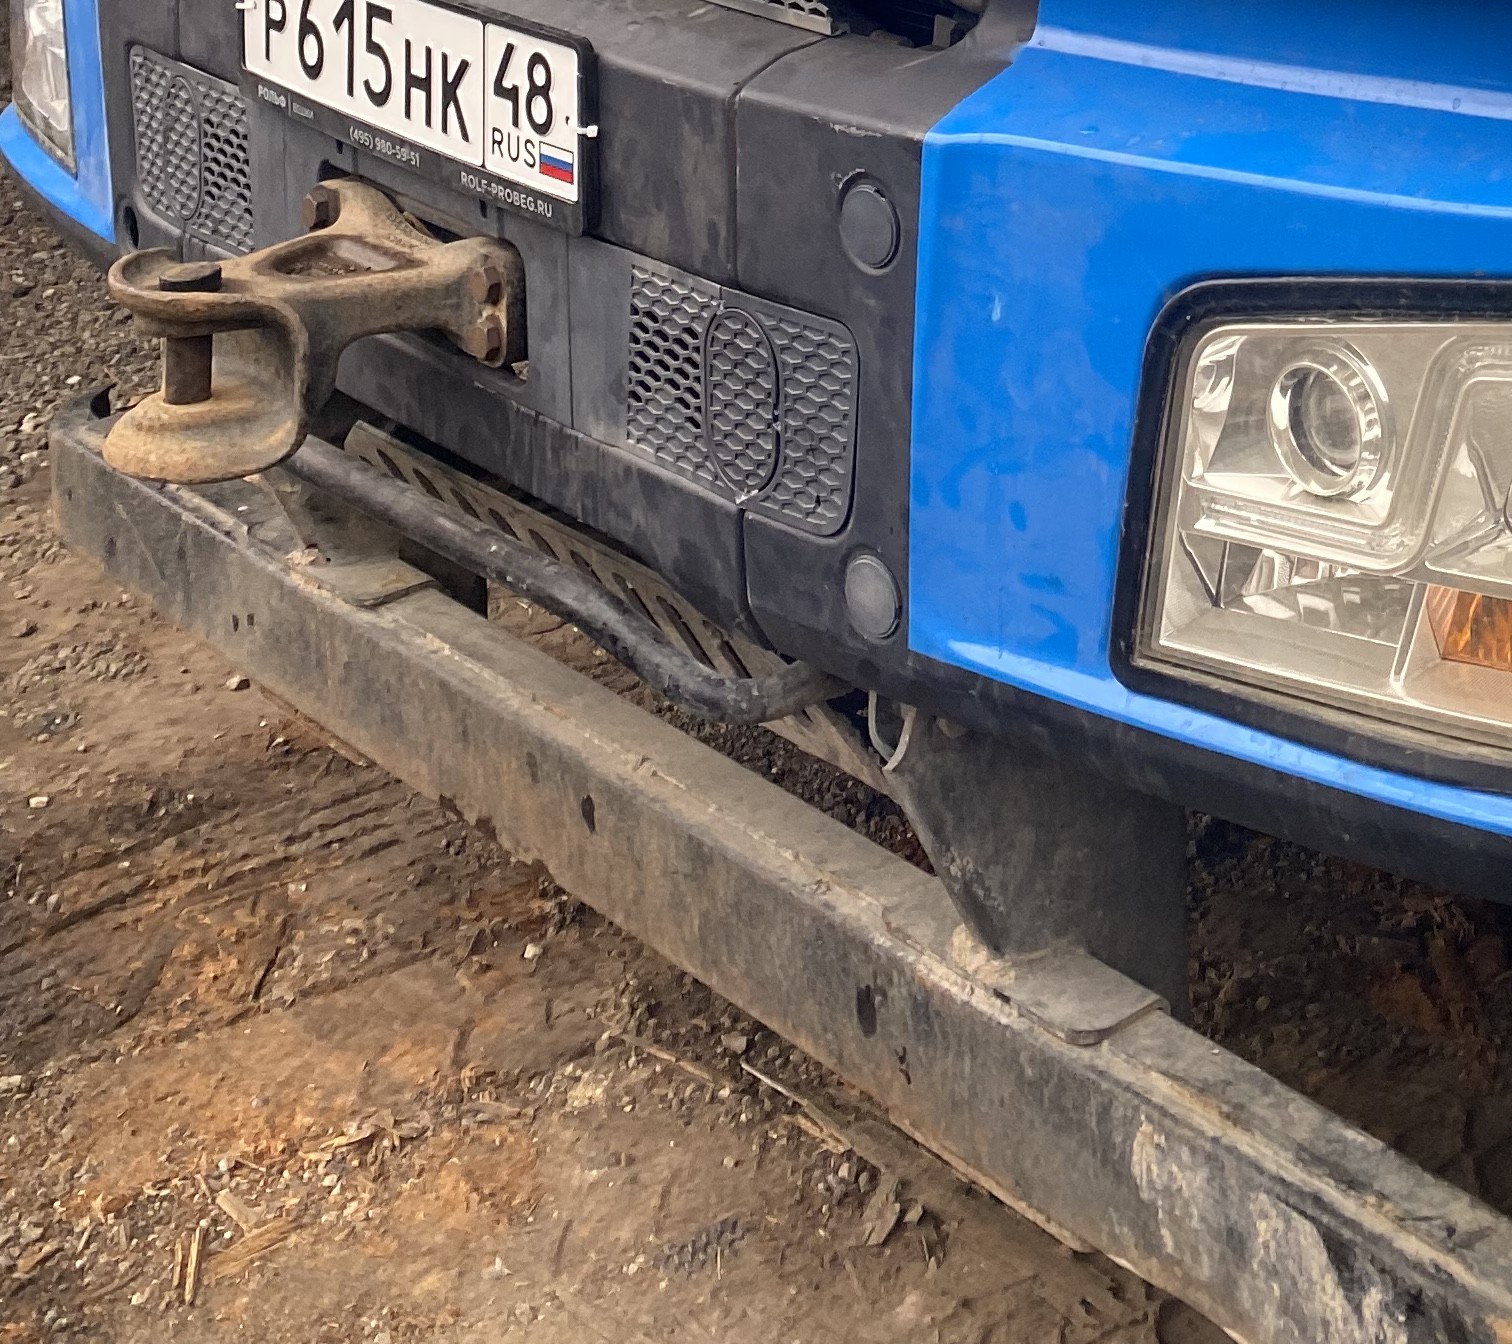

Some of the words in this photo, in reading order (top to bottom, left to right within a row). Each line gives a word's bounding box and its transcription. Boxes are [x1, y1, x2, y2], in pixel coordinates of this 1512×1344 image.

[493, 41, 553, 137] 48
[491, 126, 537, 169] RUS
[459, 170, 554, 219] ROLF-PROBEG.RU
